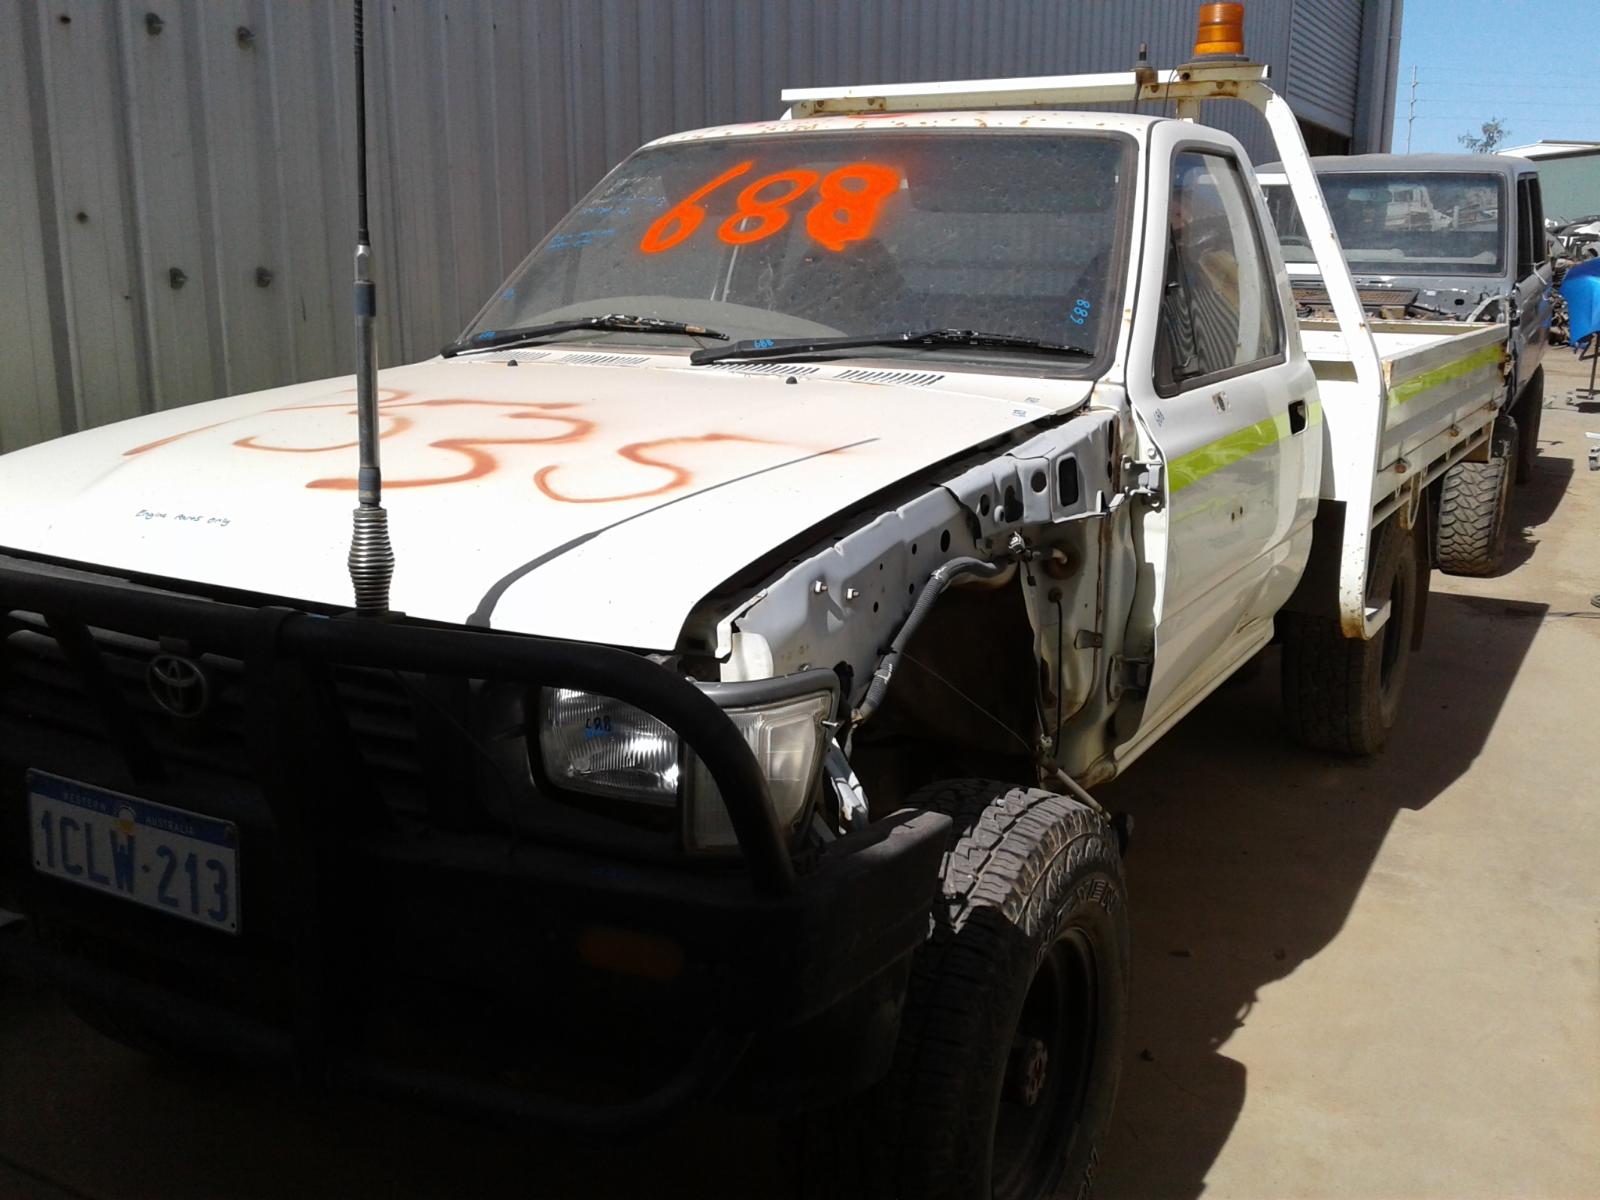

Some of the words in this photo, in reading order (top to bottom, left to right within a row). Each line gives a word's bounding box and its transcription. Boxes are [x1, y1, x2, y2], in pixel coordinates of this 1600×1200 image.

[638, 159, 902, 253] 688
[1070, 298, 1090, 325] 688
[63, 791, 107, 811] WESTERN
[144, 815, 195, 835] AUSTRALIA
